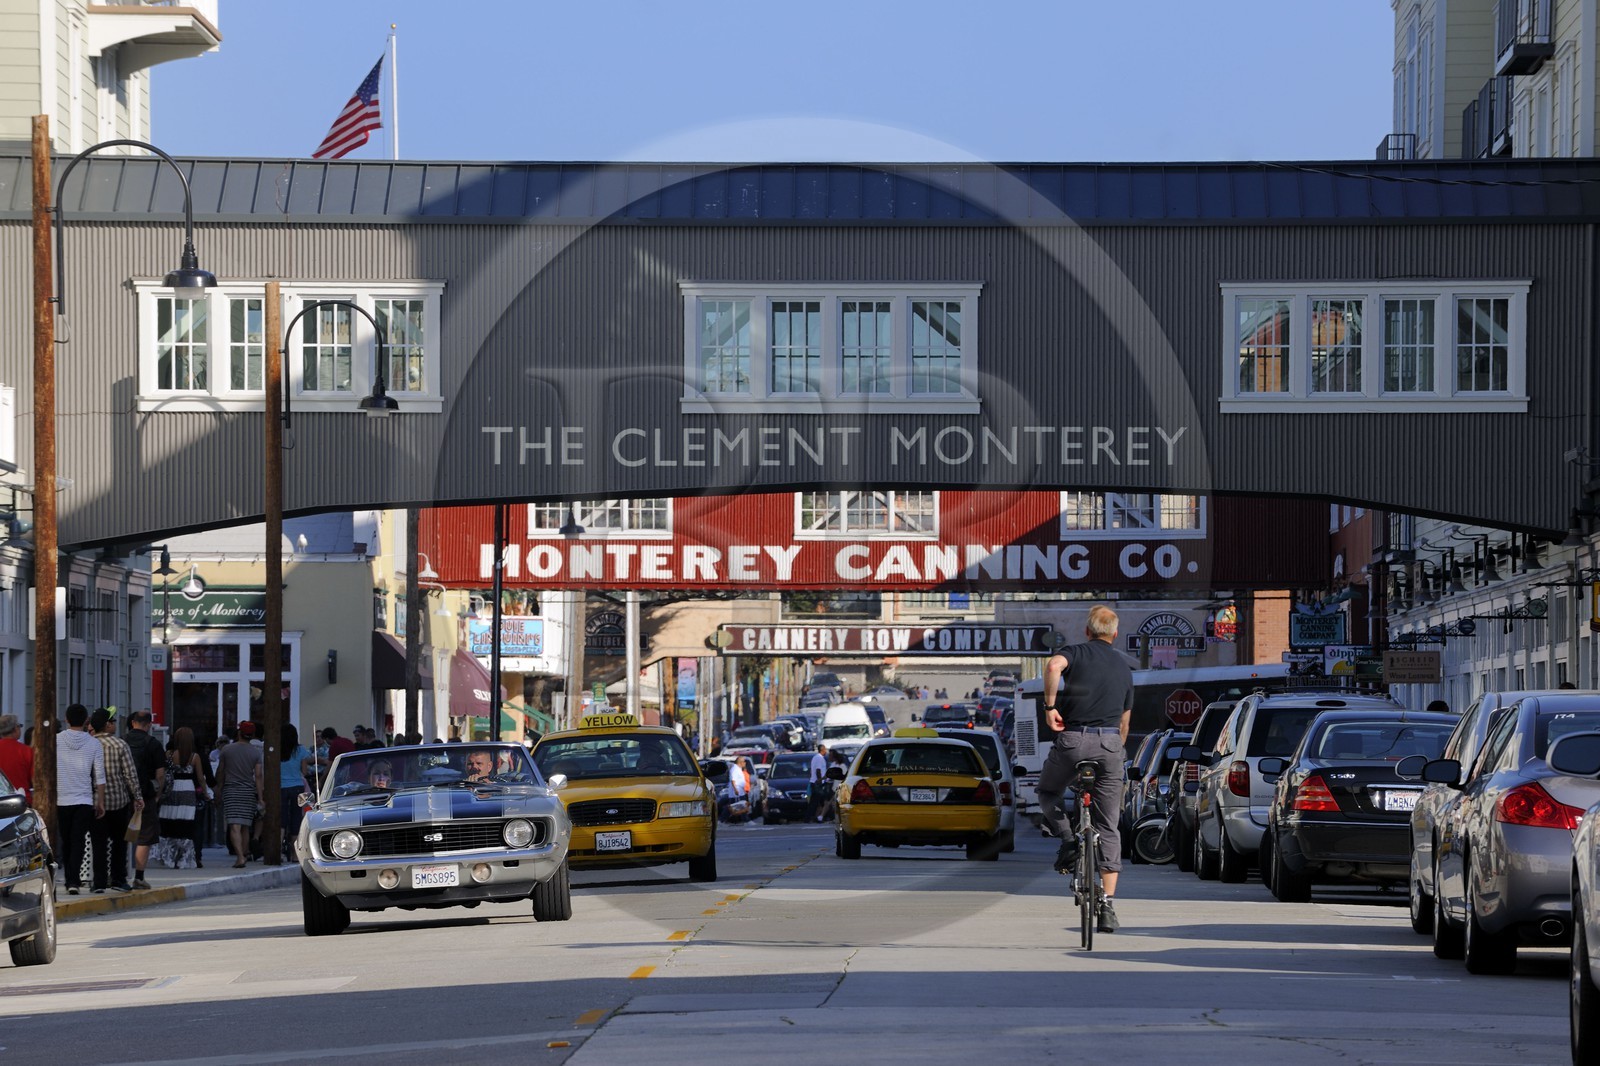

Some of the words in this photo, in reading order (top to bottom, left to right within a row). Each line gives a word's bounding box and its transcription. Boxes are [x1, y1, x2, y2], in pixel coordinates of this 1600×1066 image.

[482, 426, 584, 466] THE
[612, 427, 861, 467] CLEMENT
[891, 425, 1187, 466] MONTEREY
[480, 543, 803, 581] MONTEREY
[834, 543, 1090, 581] CANNING
[1119, 543, 1199, 578] CO.
[189, 603, 204, 621] of
[203, 599, 266, 621] Monterey
[1143, 615, 1177, 635] CANNERY
[1175, 619, 1192, 635] ROW
[1296, 616, 1339, 625] MONTEREY
[1300, 624, 1335, 632] CANNING
[742, 628, 849, 650] CANNERY
[861, 628, 911, 650] ROW
[923, 628, 1035, 650] COMPANY
[1168, 700, 1200, 714] STOP
[585, 715, 634, 727] YELLOW
[876, 777, 893, 786] 44
[1387, 797, 1415, 808] 4MBN4
[424, 832, 443, 842] SS
[415, 871, 456, 885] 5MGS895
